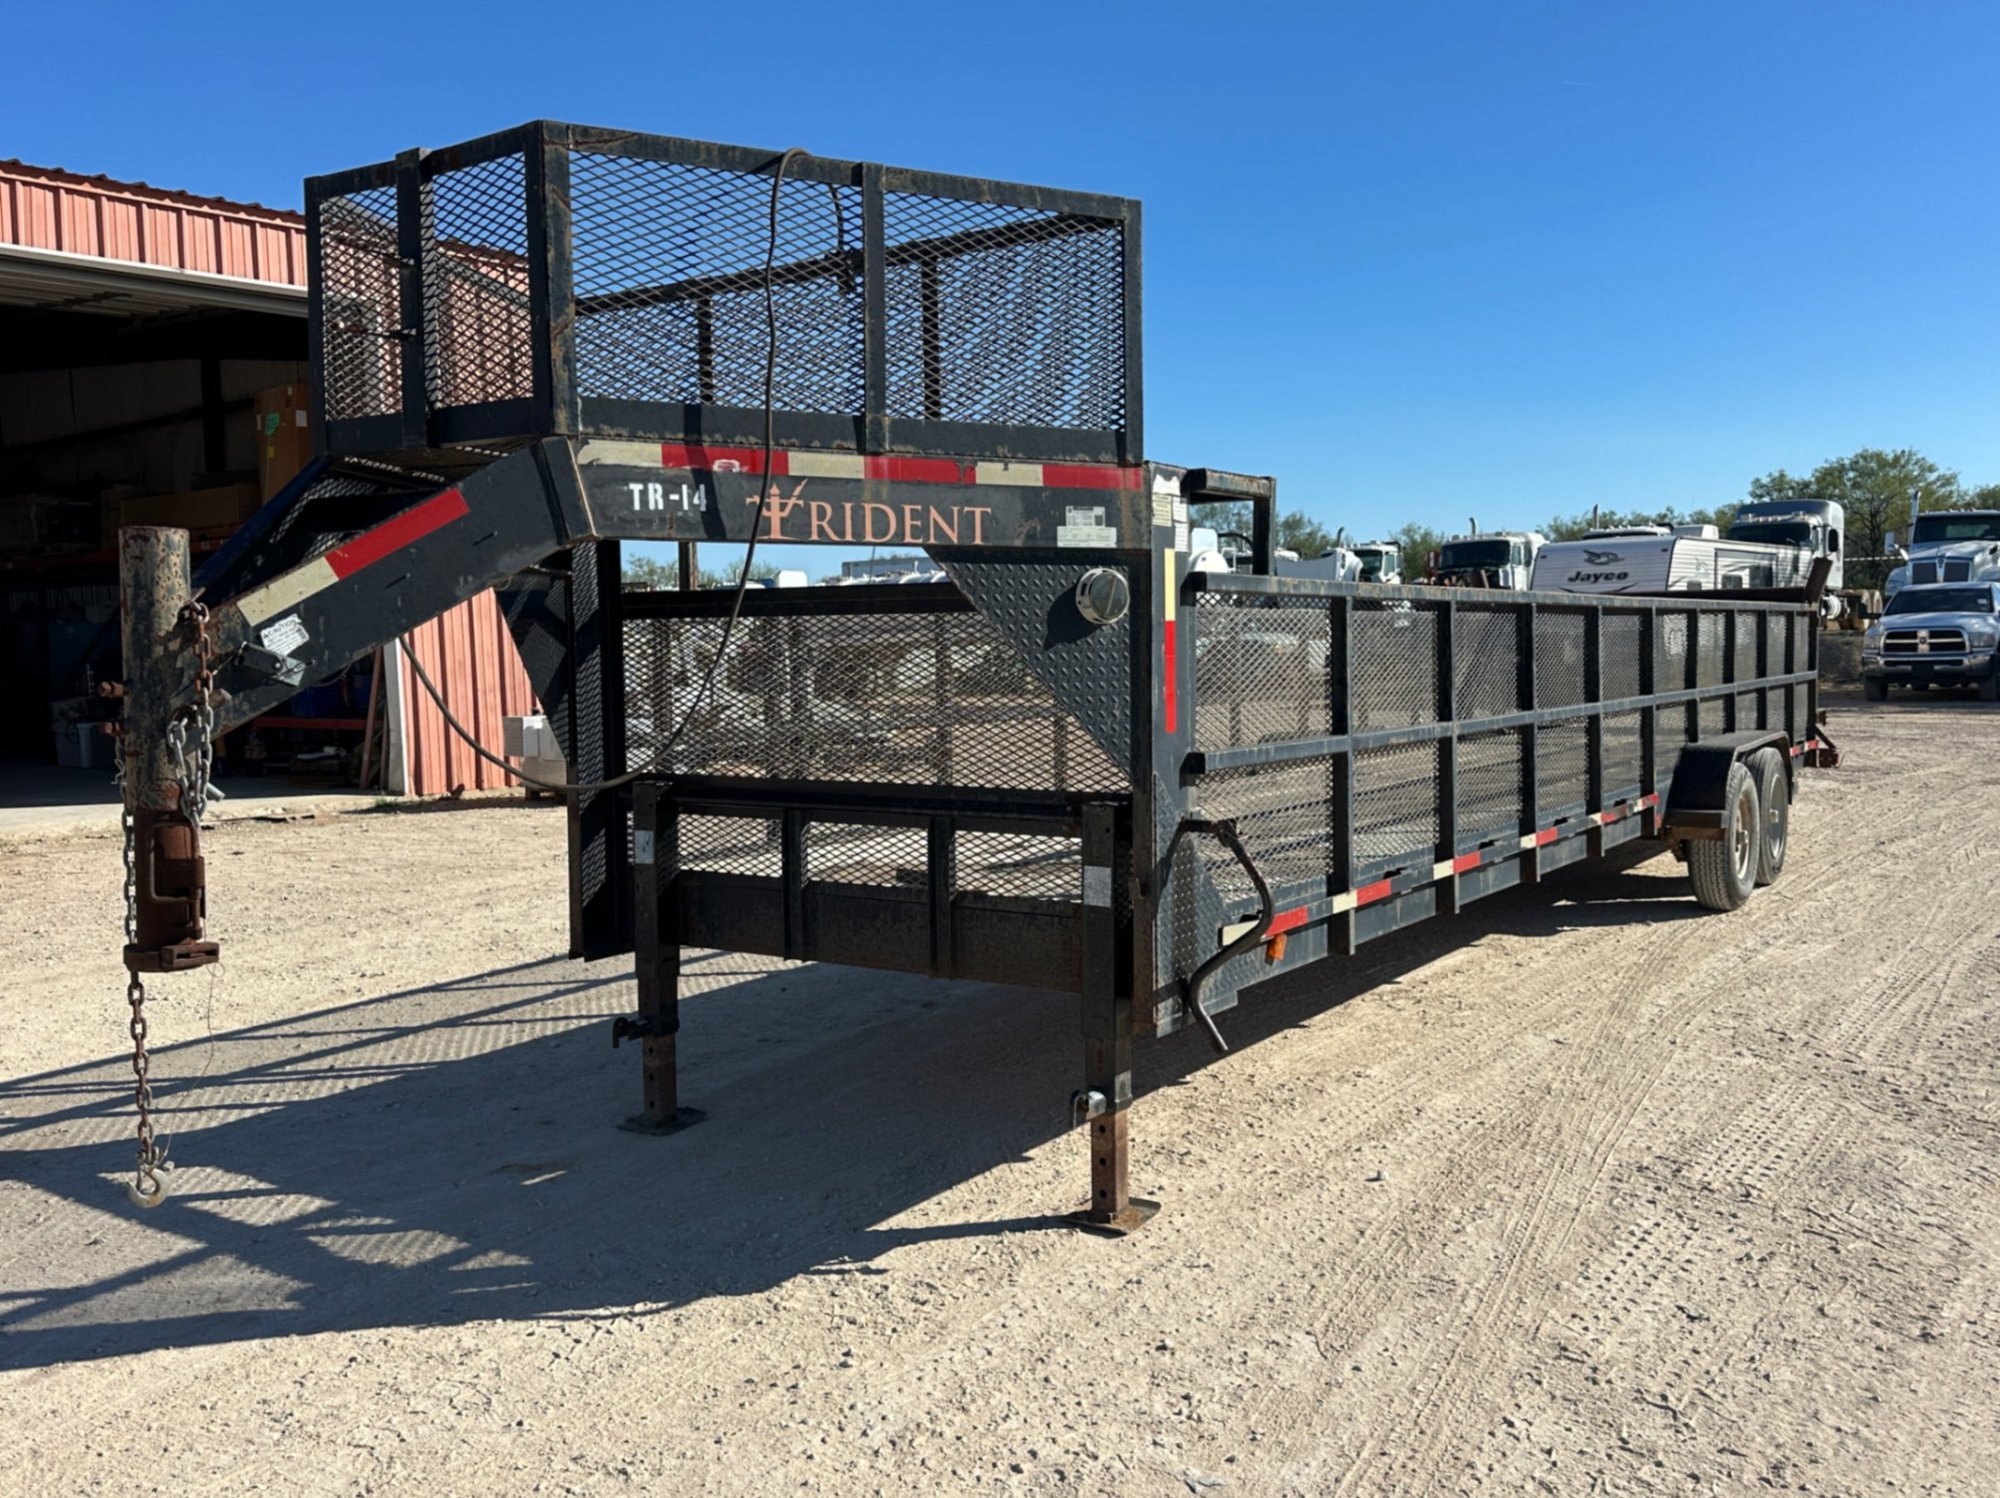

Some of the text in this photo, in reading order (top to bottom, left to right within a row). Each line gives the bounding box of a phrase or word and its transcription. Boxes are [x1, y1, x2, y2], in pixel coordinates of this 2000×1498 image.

[628, 483, 707, 512] TR-14
[746, 479, 992, 545] TRIDENT
[1568, 571, 1629, 584] Jayco
